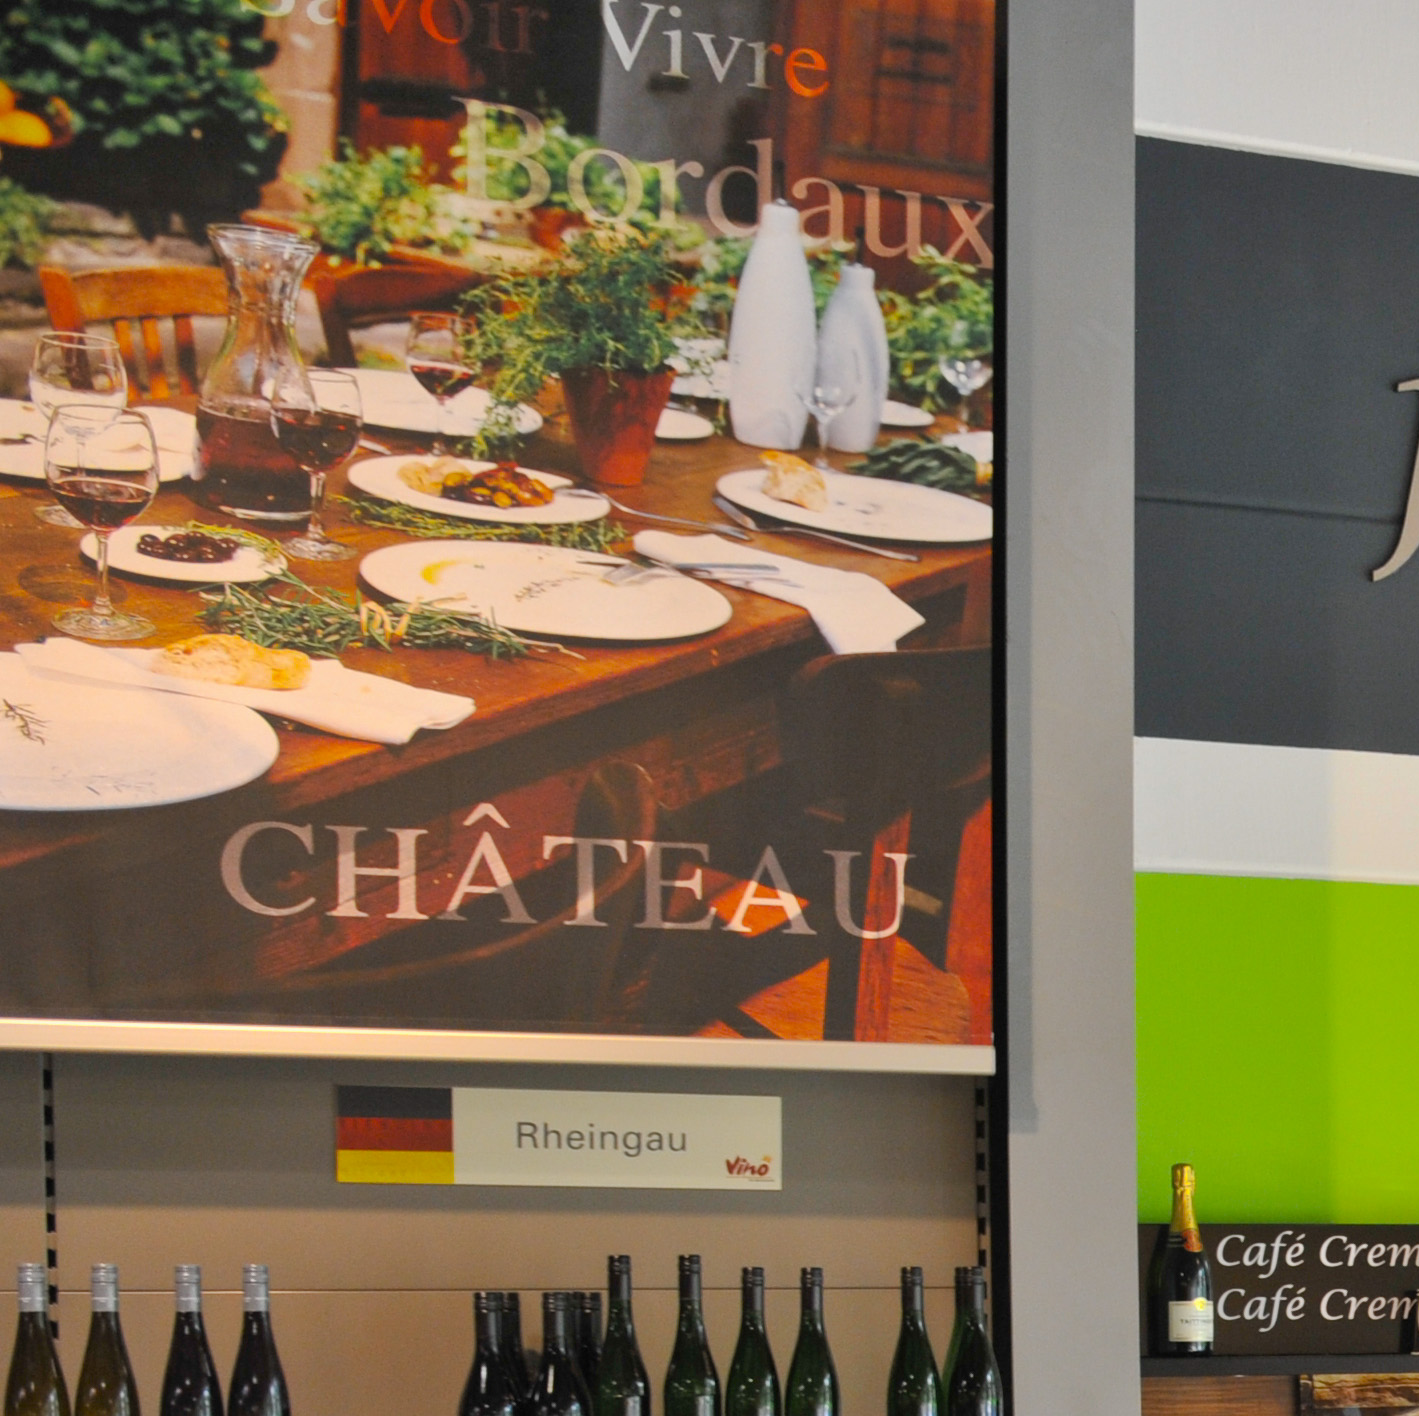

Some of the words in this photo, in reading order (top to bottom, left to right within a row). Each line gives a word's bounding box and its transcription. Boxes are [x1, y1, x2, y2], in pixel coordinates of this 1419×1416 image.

[601, 1, 830, 98] Vivre
[450, 96, 995, 269] Bordaux
[220, 803, 917, 939] CHÂTEAU
[515, 1120, 687, 1157] Rheingau
[725, 1155, 771, 1177] Vino
[1216, 1230, 1306, 1276] Café
[1217, 1284, 1306, 1333] Café
[1319, 1288, 1418, 1321] Crem
